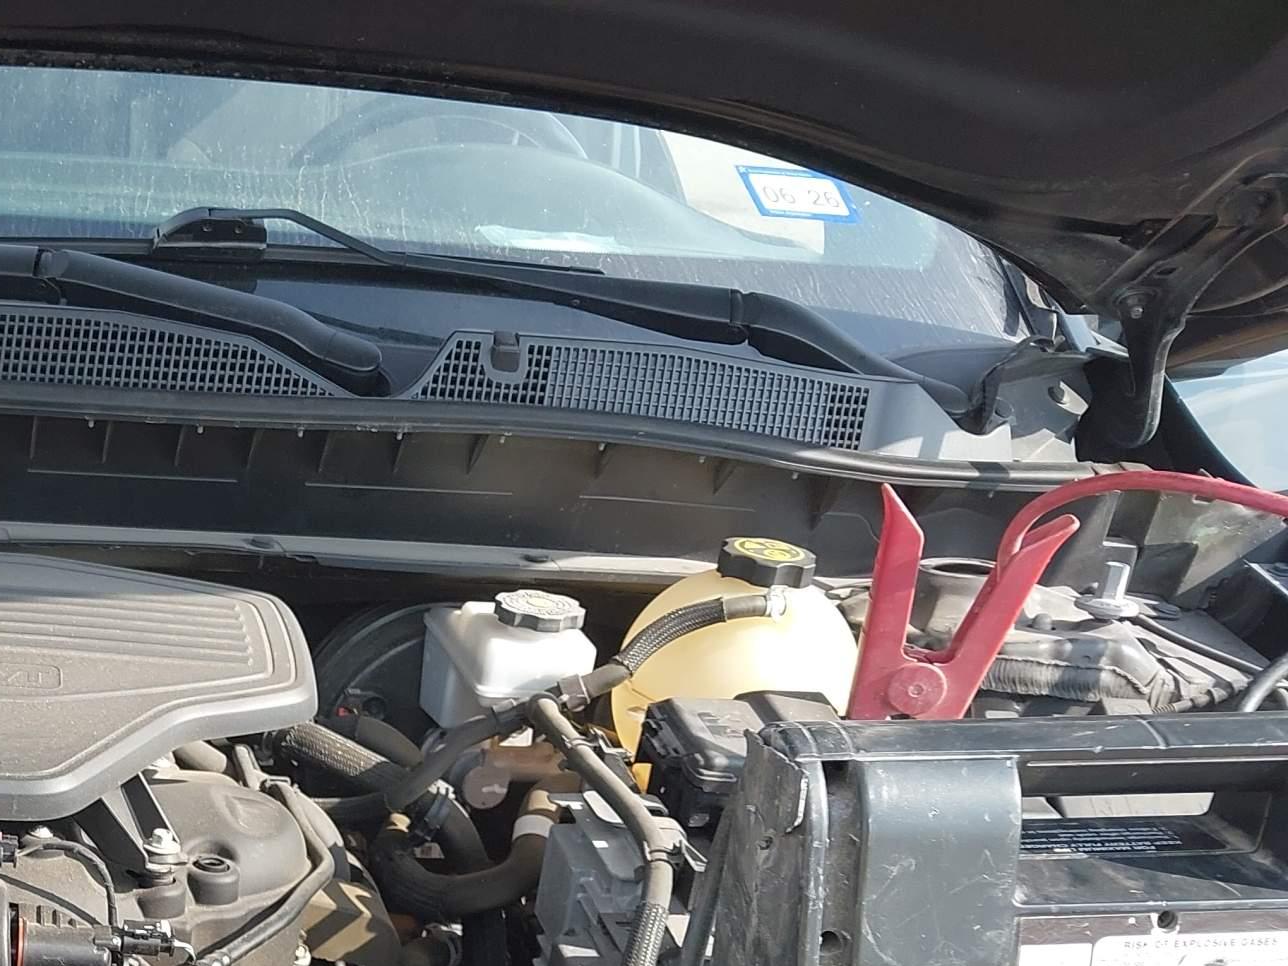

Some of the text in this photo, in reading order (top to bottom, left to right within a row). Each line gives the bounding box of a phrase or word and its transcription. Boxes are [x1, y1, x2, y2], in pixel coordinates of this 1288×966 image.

[762, 186, 840, 208] 06 26
[1241, 937, 1279, 947] GASES
